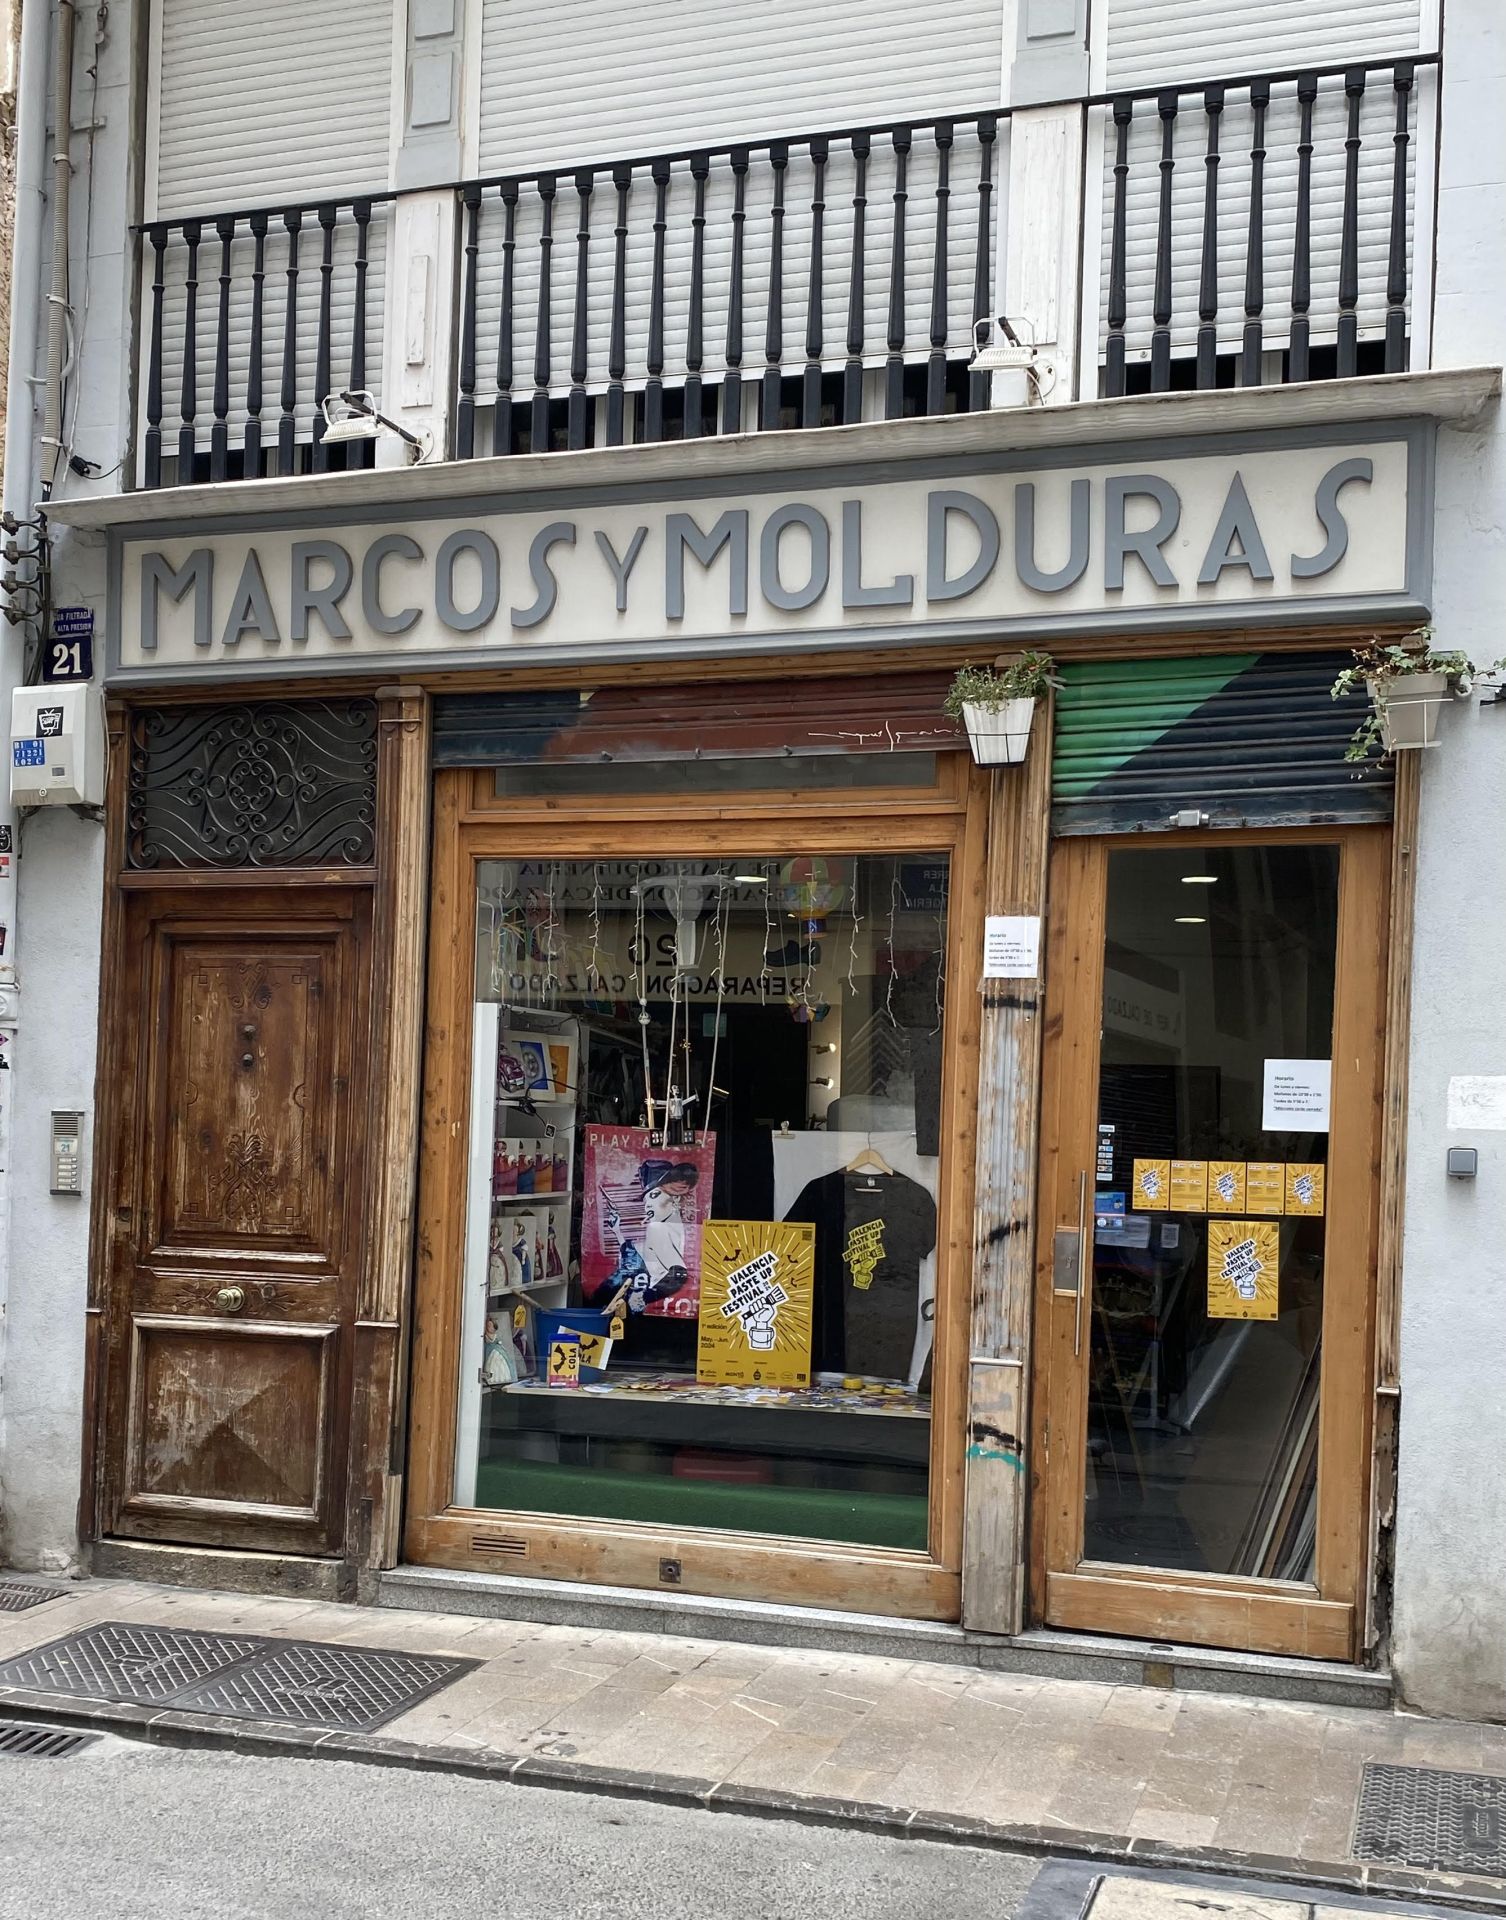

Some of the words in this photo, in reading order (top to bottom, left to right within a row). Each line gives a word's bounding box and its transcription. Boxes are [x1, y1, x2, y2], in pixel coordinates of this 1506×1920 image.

[140, 521, 576, 649] MARCOS
[594, 526, 649, 613] Y
[665, 457, 1373, 622] MOLDURAS
[52, 642, 82, 675] 21
[590, 1133, 630, 1147] PLAY
[851, 1221, 883, 1239] VALENCIA
[870, 1230, 880, 1239] UP
[1225, 1239, 1255, 1260] VALENCIA
[1226, 1254, 1246, 1268] PASTE
[1245, 1248, 1254, 1257] UP
[729, 1253, 776, 1286] VALENCIA
[1220, 1260, 1249, 1279] FESTIVAL
[730, 1275, 761, 1299] PASTE
[759, 1266, 773, 1280] UP
[721, 1286, 765, 1317] FESTIVAL
[568, 1347, 577, 1370] COLA
